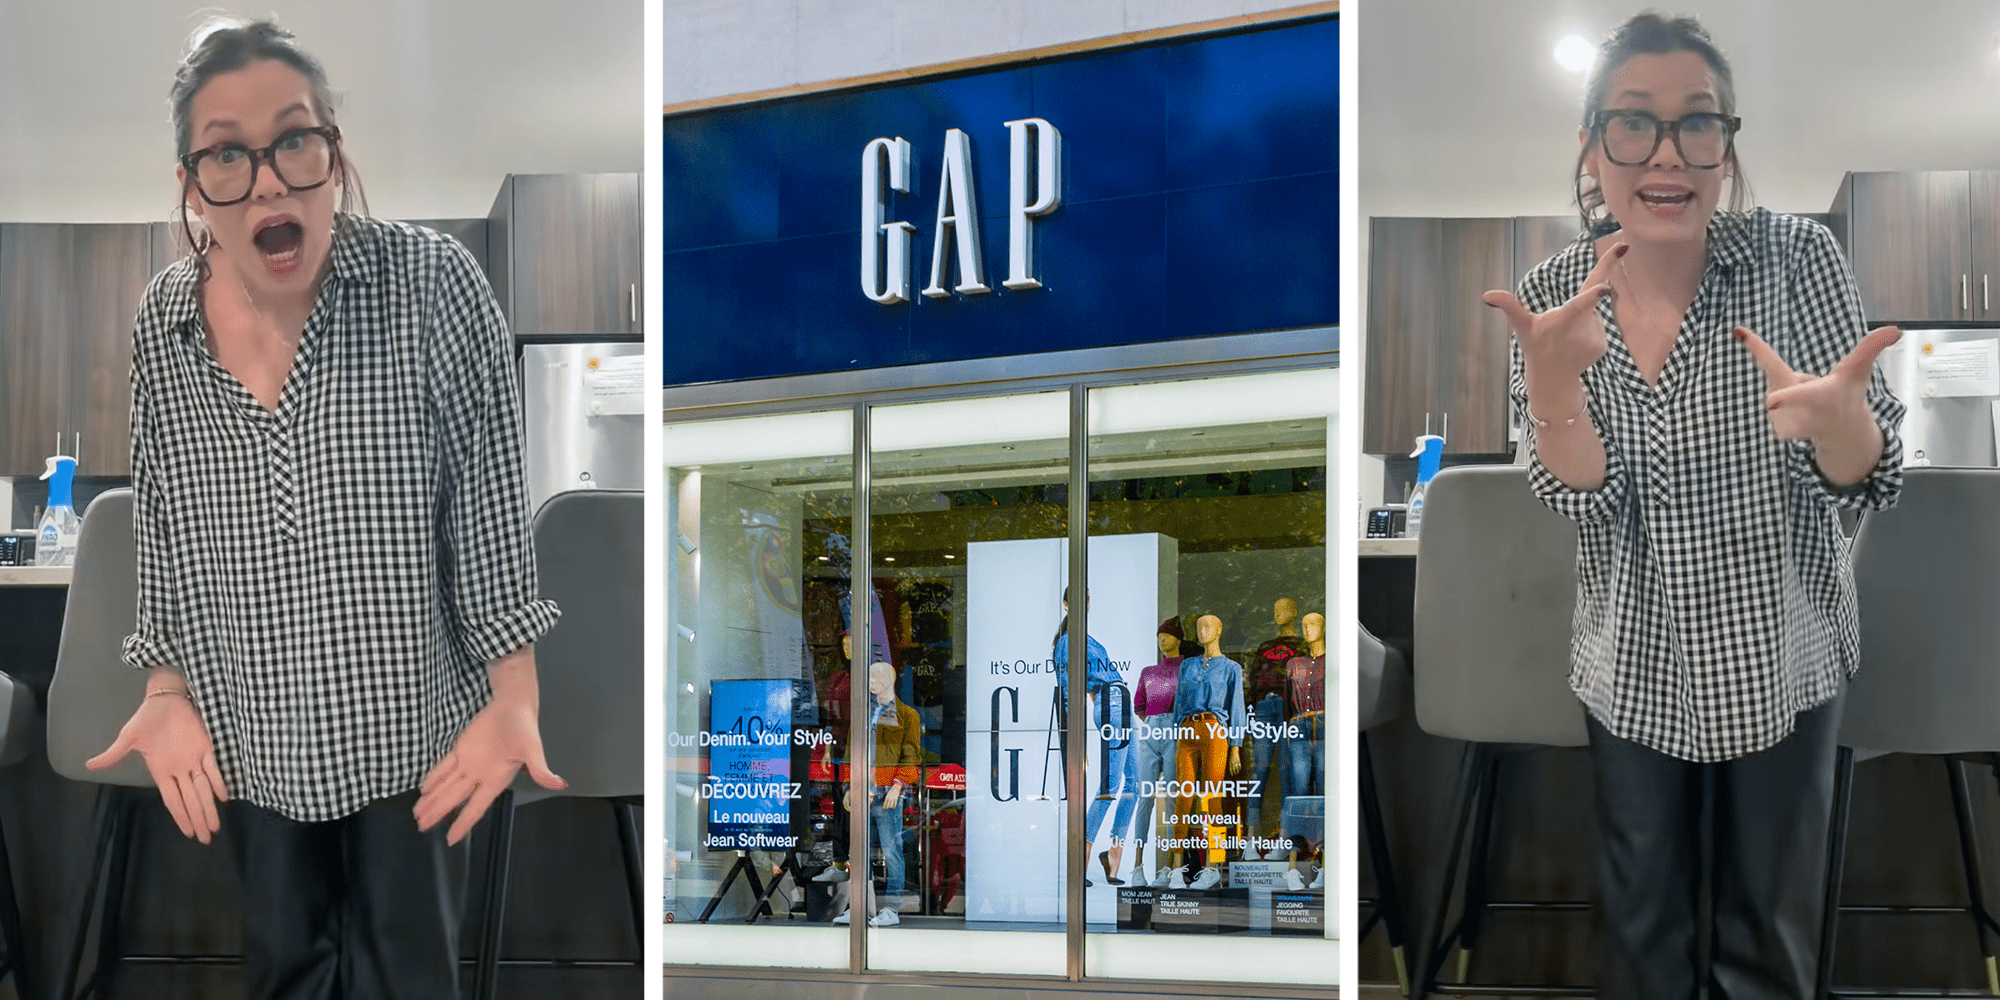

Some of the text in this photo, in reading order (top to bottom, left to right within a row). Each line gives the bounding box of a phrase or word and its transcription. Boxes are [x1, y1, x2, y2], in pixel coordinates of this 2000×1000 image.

[860, 117, 1062, 304] GAP
[1014, 660, 1042, 675] Our
[1097, 658, 1131, 672] Now
[668, 729, 837, 749] Our Denim. Your Style.
[1100, 721, 1304, 742] Our Denim. Your Style.
[990, 683, 1131, 803] GAP
[725, 773, 773, 783] FEMME ET
[1141, 776, 1261, 798] DÉCOUVREZ
[701, 778, 802, 799] DÉCOUVREZ
[714, 810, 789, 824] Le nouveau
[1162, 812, 1240, 825] Le nouveau
[703, 832, 798, 847] Jean Softwear
[1149, 836, 1208, 852] igarette
[1212, 836, 1247, 849] Taille
[1251, 836, 1293, 849] Haute
